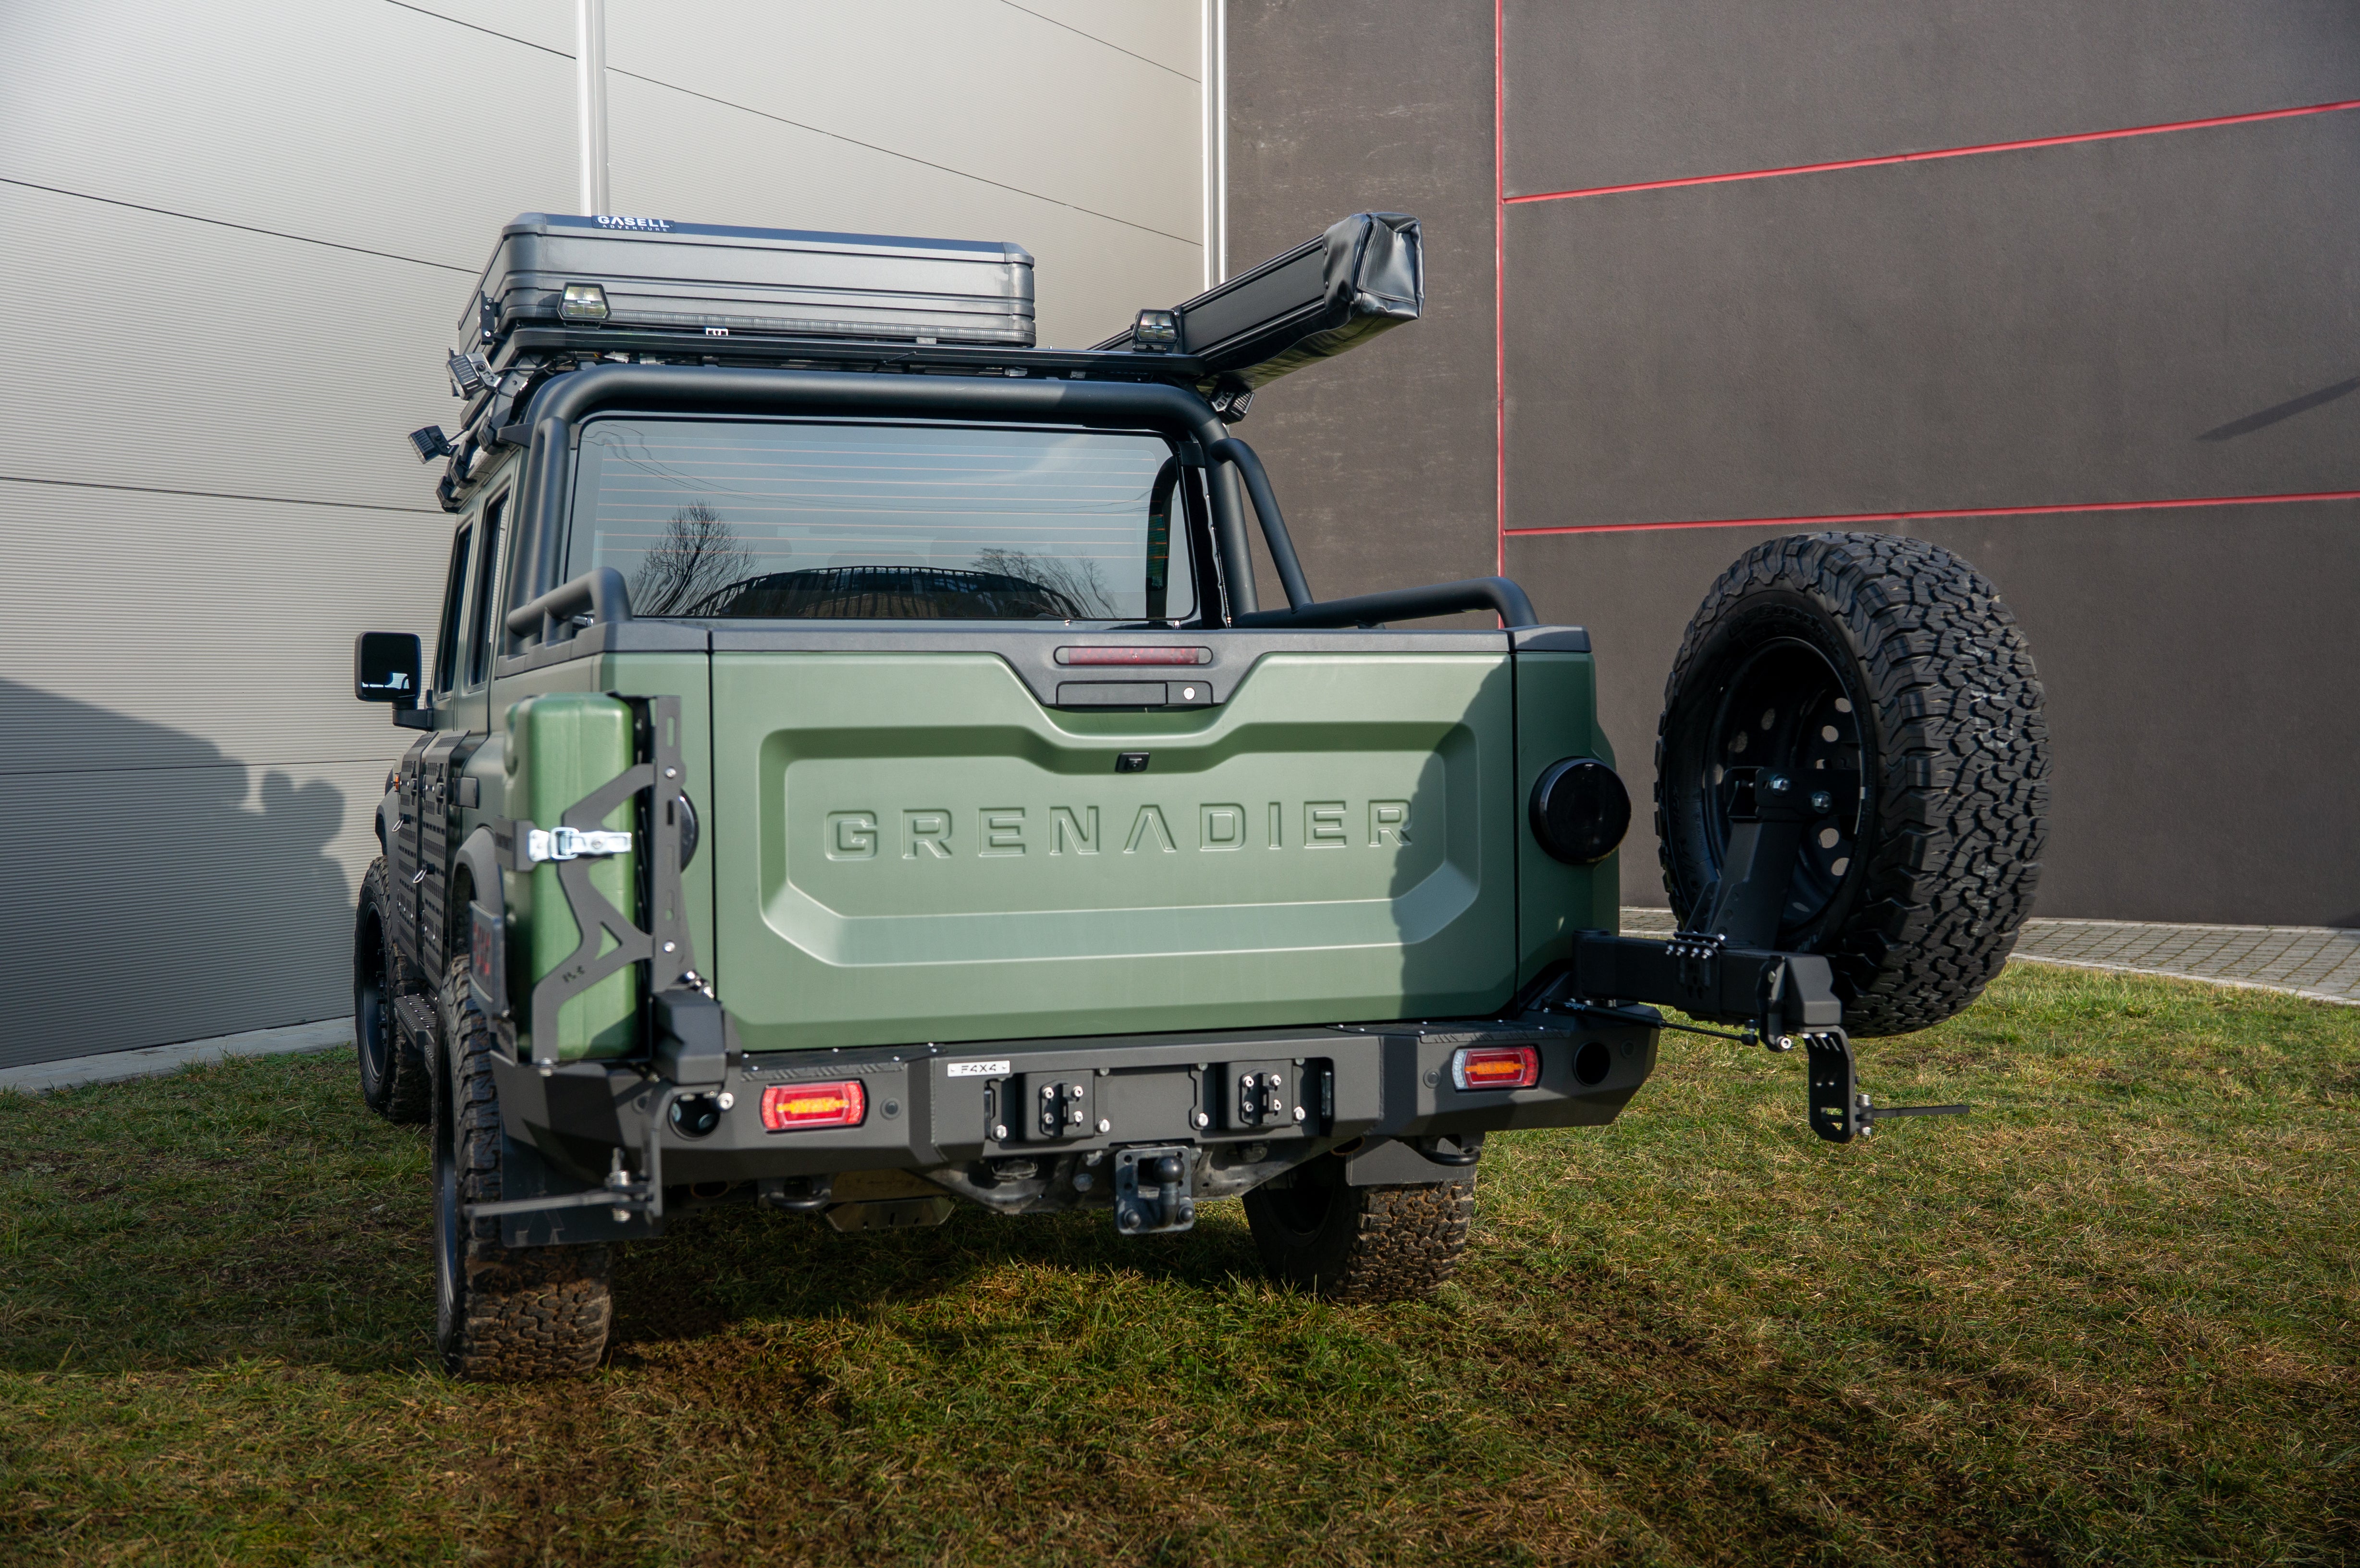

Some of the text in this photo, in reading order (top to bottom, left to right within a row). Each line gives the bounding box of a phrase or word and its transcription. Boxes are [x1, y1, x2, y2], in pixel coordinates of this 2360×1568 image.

[598, 216, 670, 228] GASELL
[825, 798, 1414, 861] GRENADIER
[961, 1064, 996, 1073] F4X4
